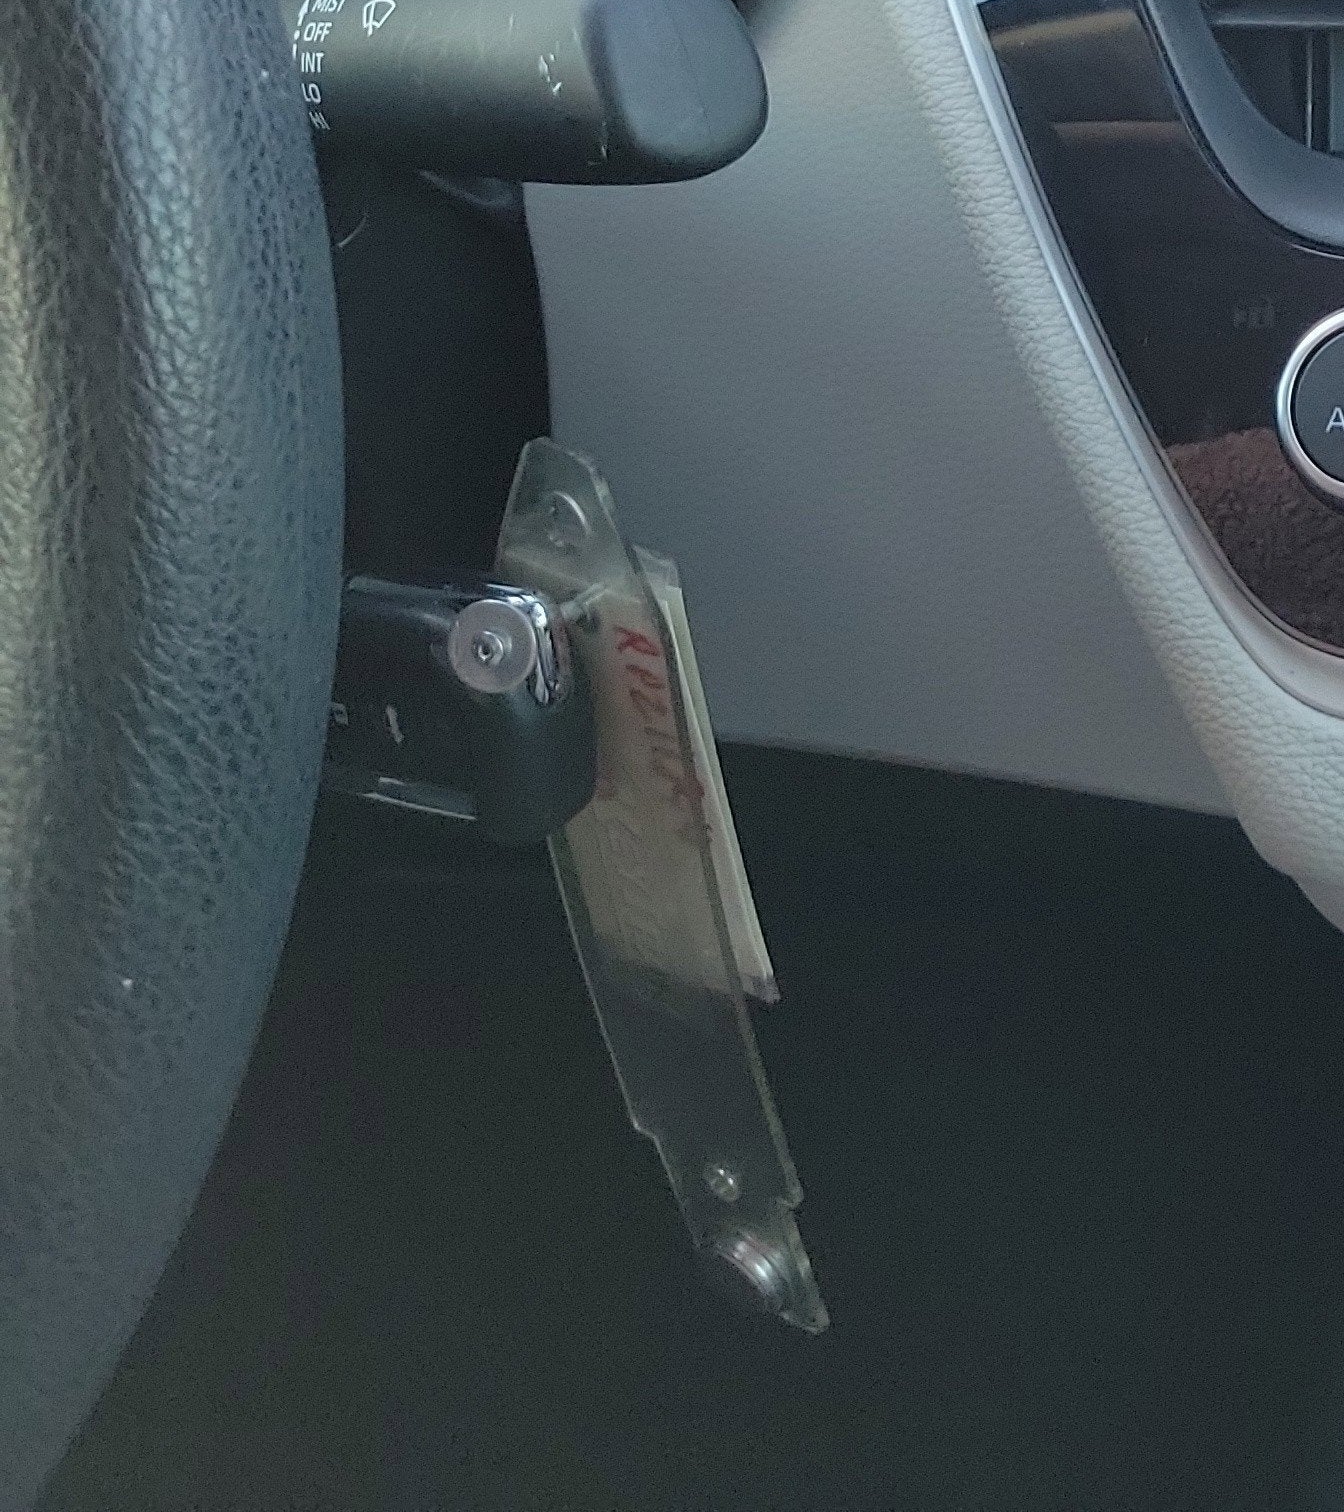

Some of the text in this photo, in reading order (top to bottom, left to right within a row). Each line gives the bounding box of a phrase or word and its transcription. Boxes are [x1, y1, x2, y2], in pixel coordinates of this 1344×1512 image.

[303, 22, 333, 43] OFF
[300, 51, 325, 73] INT
[301, 82, 322, 105] LO
